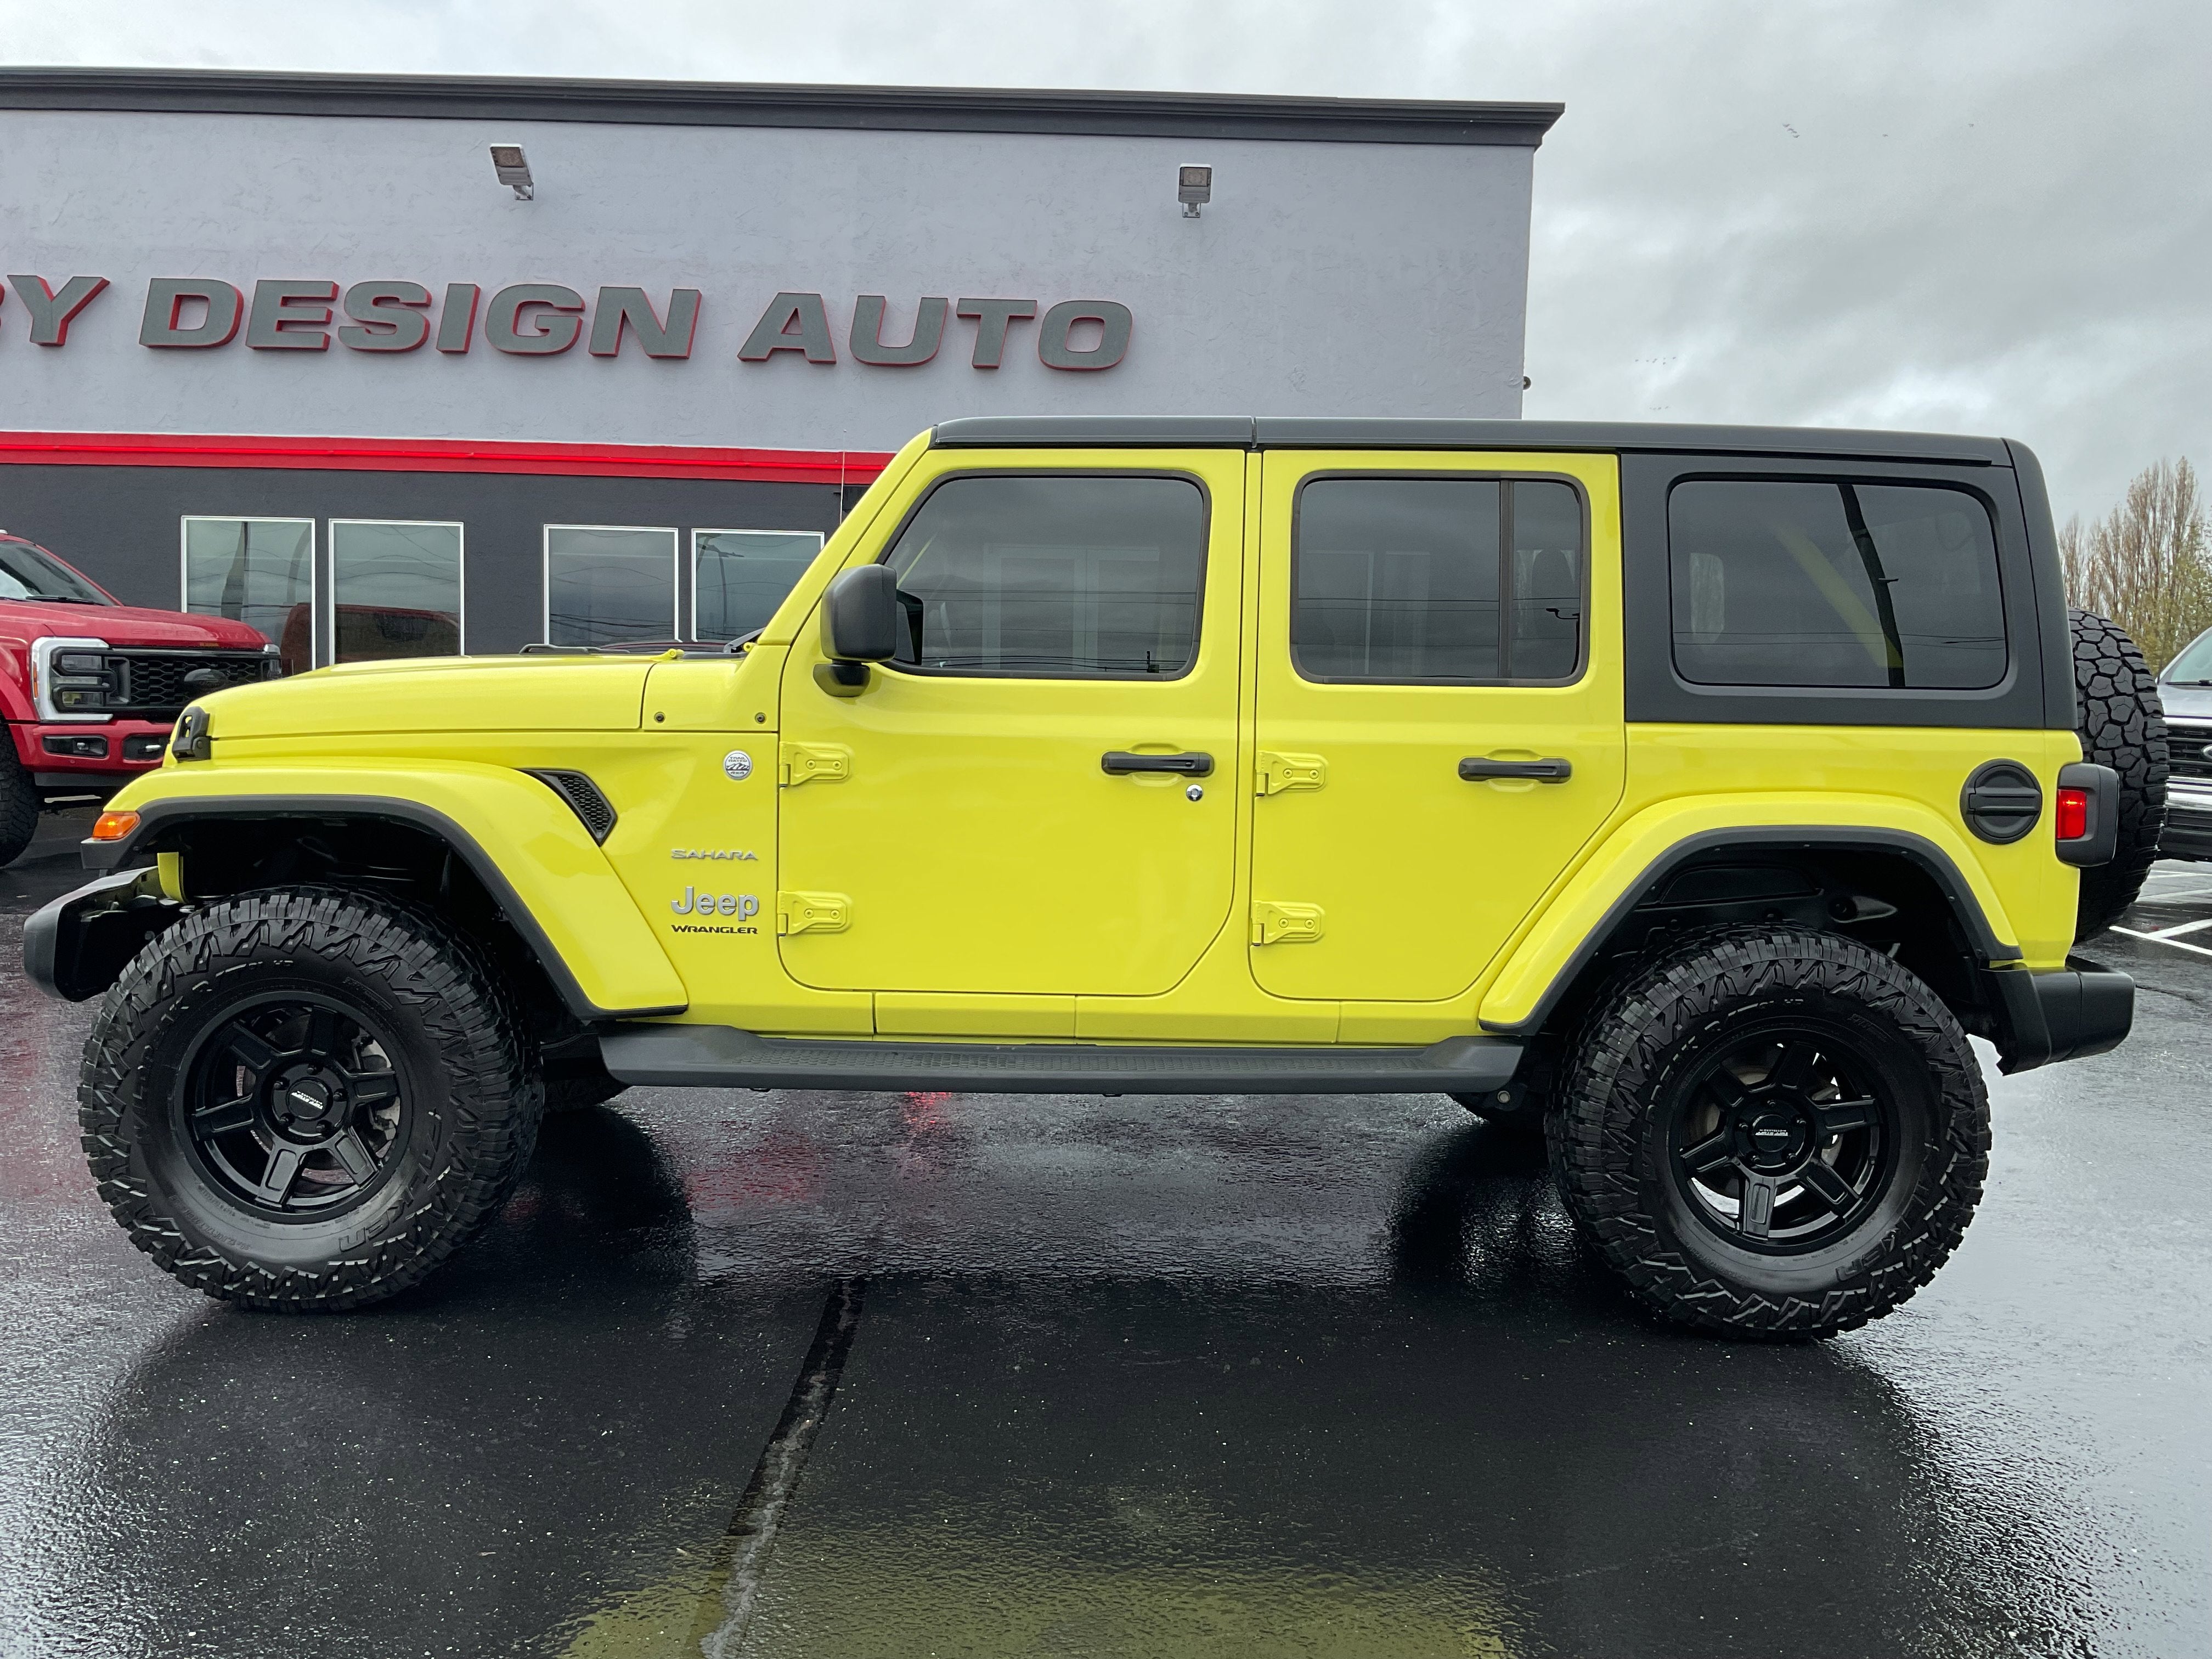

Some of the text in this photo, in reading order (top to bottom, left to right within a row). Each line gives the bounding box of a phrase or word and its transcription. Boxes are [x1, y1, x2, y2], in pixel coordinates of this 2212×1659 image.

[0, 274, 1133, 371] Y DESIGN AUTO
[671, 849, 758, 860] SAHARA
[671, 886, 759, 921] Jeep
[671, 924, 759, 935] WRANGLER
